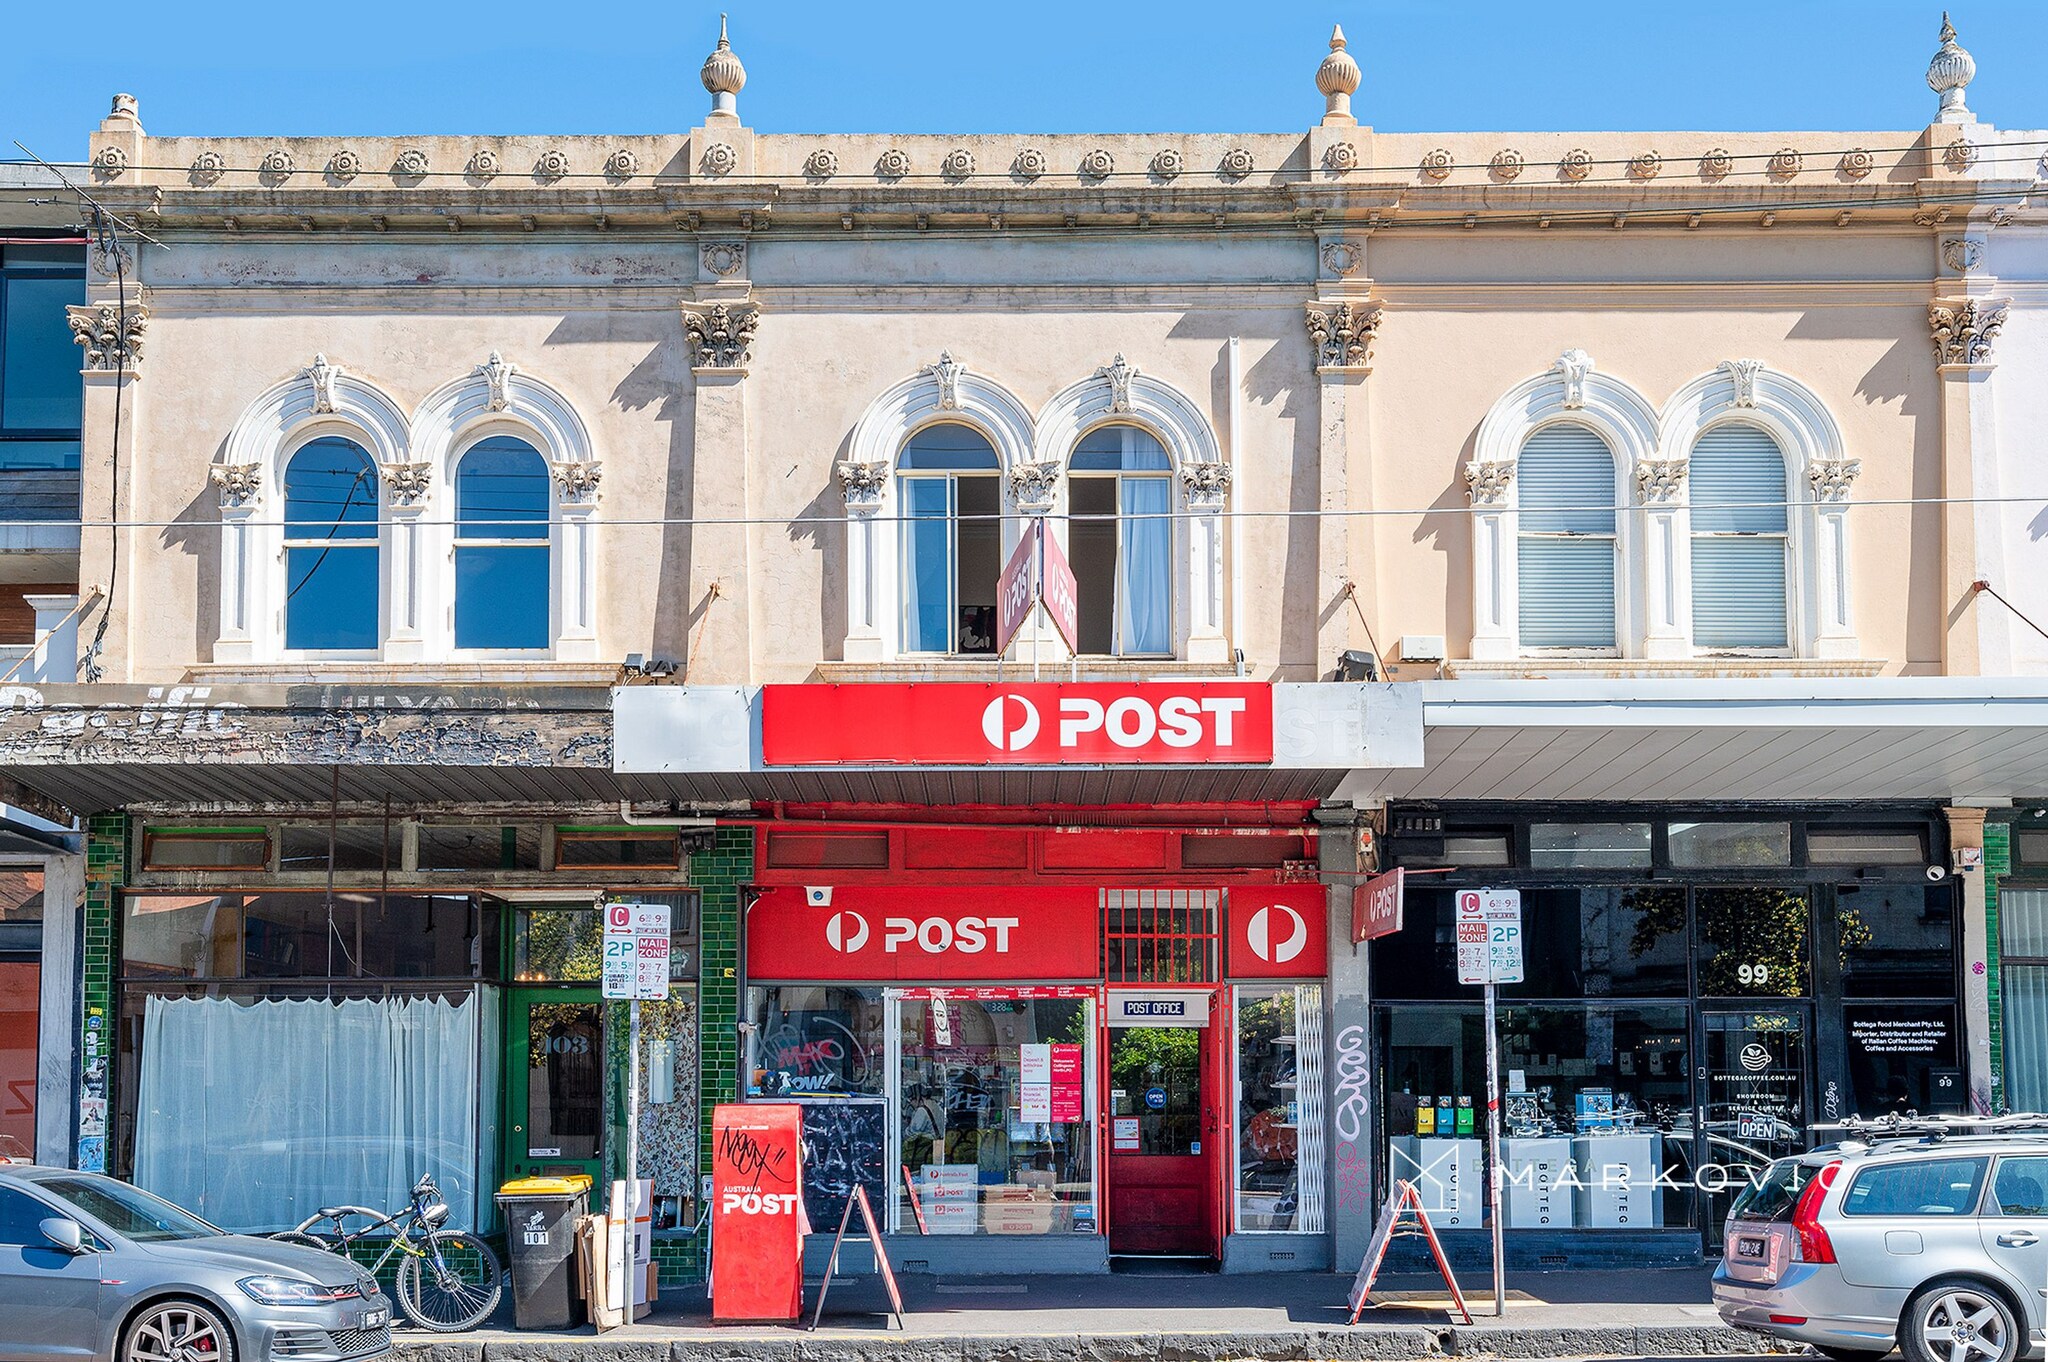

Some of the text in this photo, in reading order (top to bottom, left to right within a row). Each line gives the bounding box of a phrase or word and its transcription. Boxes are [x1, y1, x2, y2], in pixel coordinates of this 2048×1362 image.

[1059, 697, 1246, 748] POST
[1376, 884, 1397, 920] POST
[885, 917, 1019, 953] POST
[1460, 923, 1486, 933] MAIL
[1492, 926, 1519, 942] 2P
[640, 939, 667, 948] MAIL
[1459, 933, 1487, 942] ZONE
[607, 941, 634, 957] 2P
[638, 949, 668, 958] ZONE
[1737, 964, 1769, 985] 99
[1127, 1002, 1182, 1014] POST OFFICE
[1853, 1021, 1877, 1029] Bottega
[544, 1035, 589, 1055] 103
[1938, 1078, 1953, 1087] 99
[1740, 1121, 1773, 1138] OPEN
[722, 1193, 798, 1214] POST
[525, 1232, 547, 1244] 101
